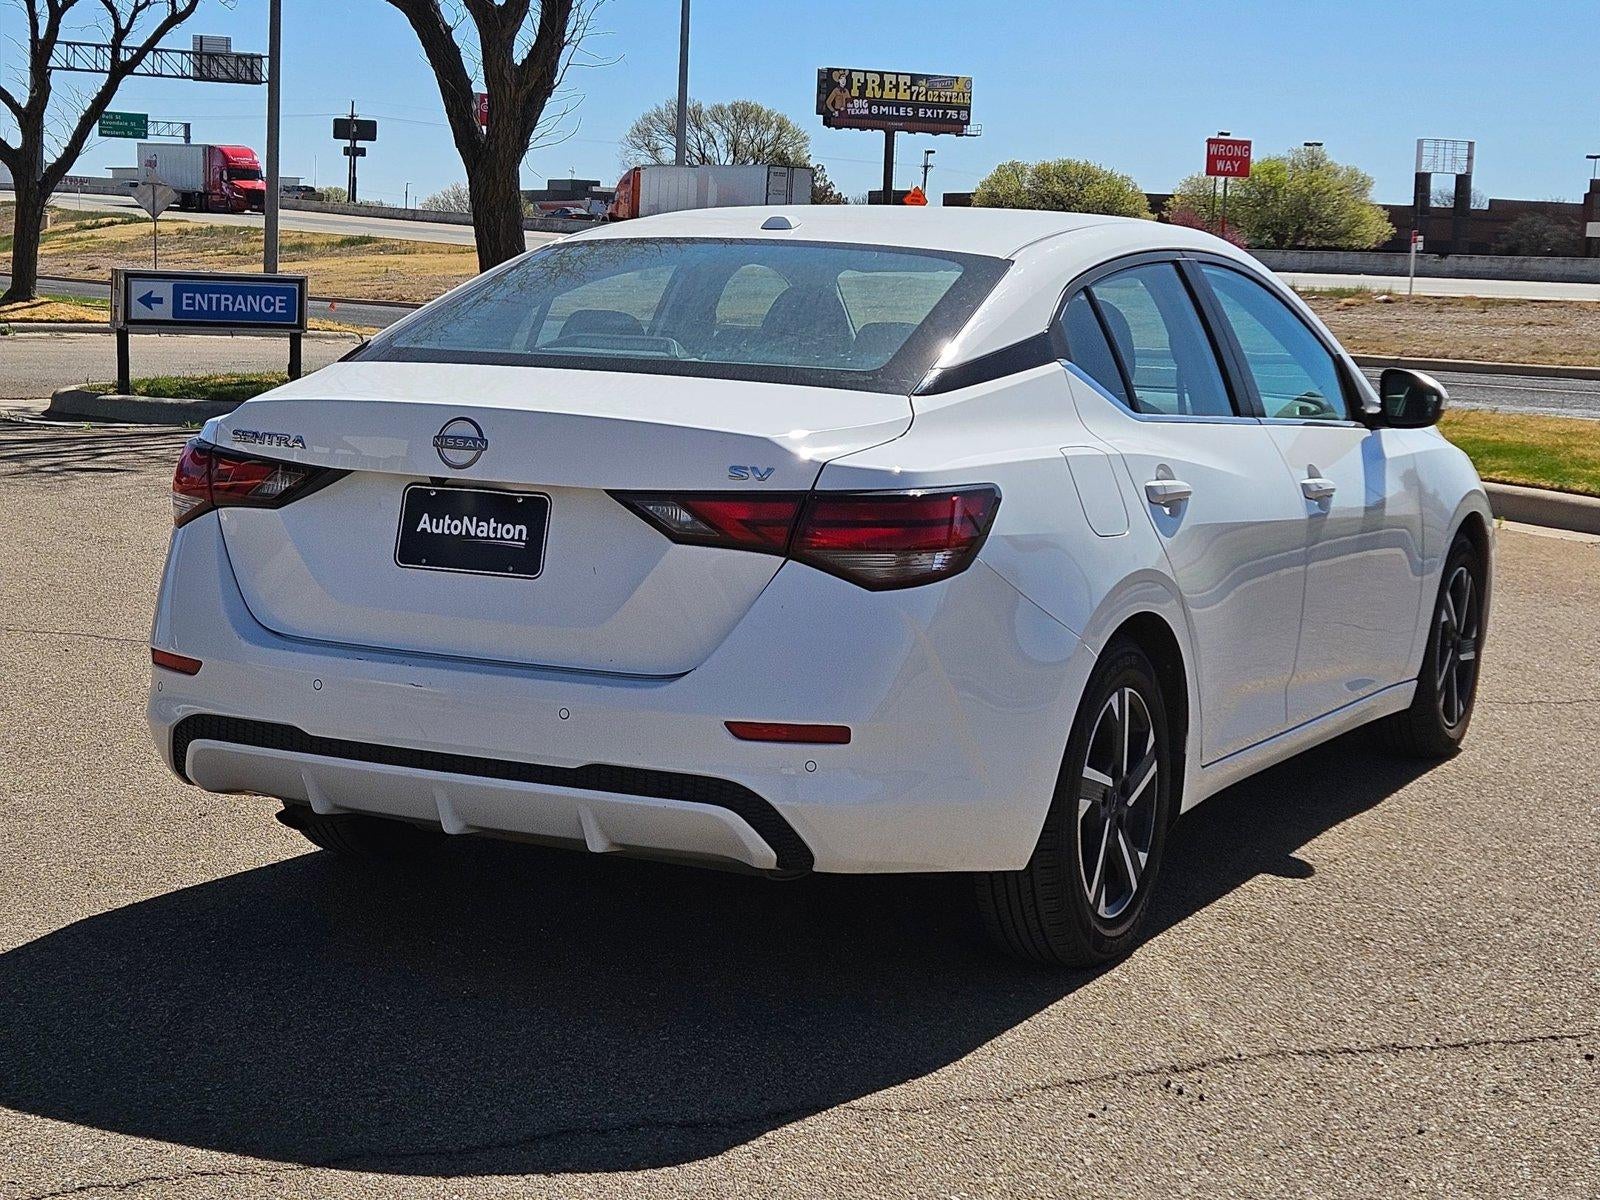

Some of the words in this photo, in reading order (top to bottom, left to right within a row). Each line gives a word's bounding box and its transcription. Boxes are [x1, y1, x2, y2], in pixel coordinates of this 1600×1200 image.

[851, 71, 911, 101] FREE
[853, 99, 869, 108] BIG
[911, 86, 926, 101] 72
[927, 91, 939, 102] OZ
[940, 91, 971, 104] STEAK
[871, 105, 879, 114] 8
[879, 106, 914, 116] MILES
[918, 108, 944, 118] EXIT
[945, 110, 958, 119] 75
[1209, 143, 1250, 157] WRONG
[1216, 159, 1241, 172] WAY
[181, 292, 288, 314] ENTRANCE
[232, 429, 306, 450] SENTRA
[433, 435, 488, 451] NISSAN
[728, 465, 776, 482] SV
[416, 512, 528, 541] AutoNation
